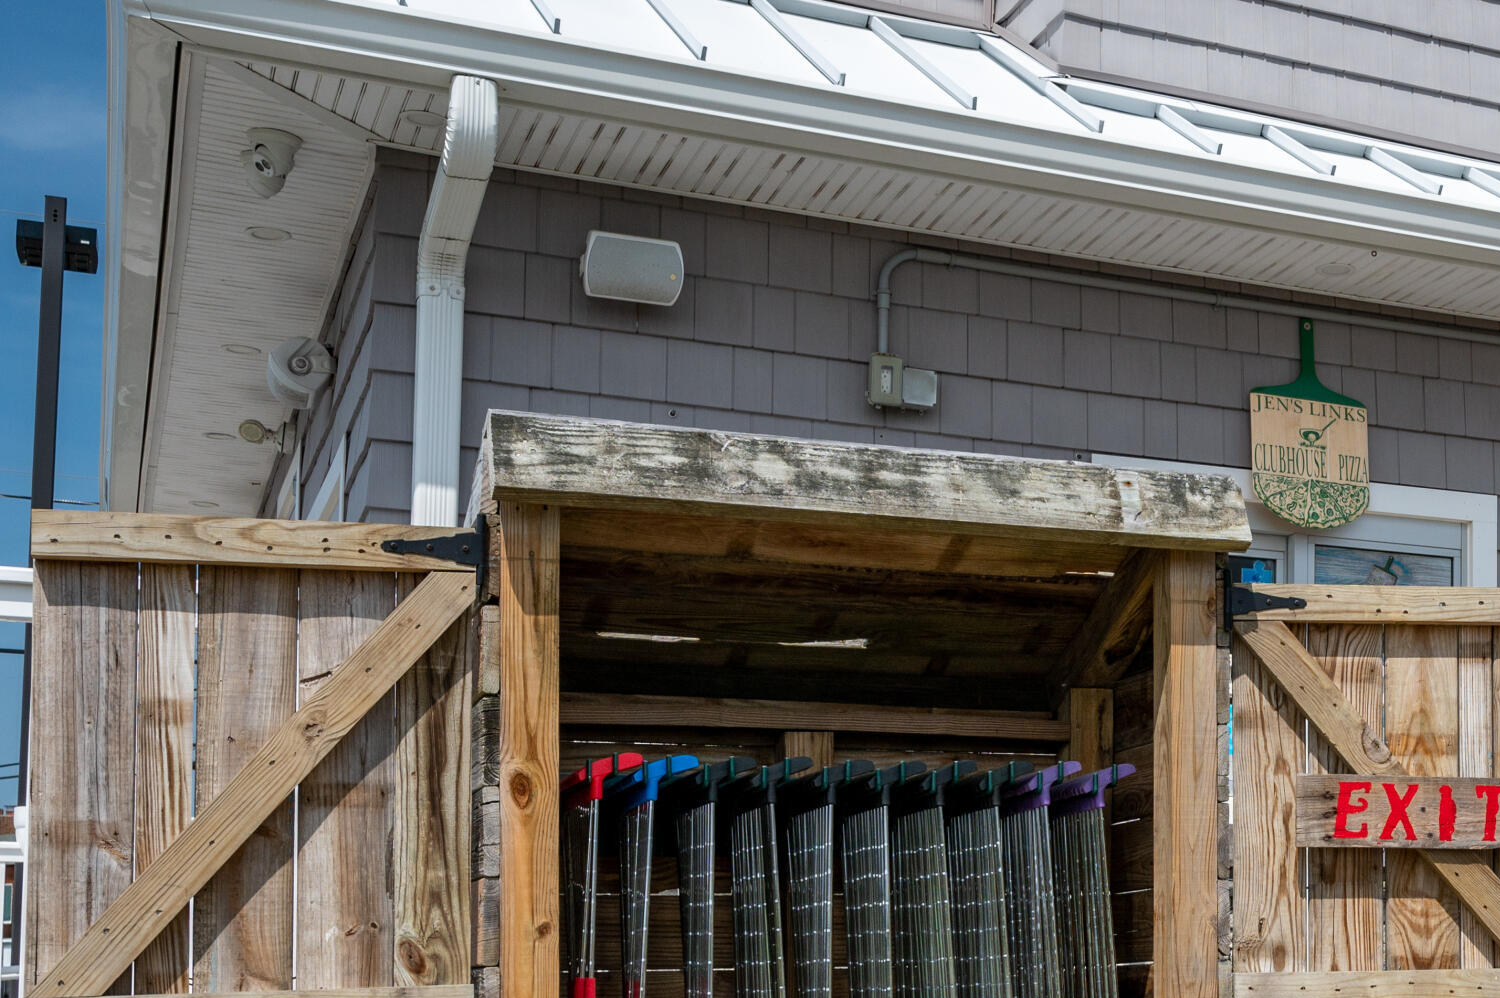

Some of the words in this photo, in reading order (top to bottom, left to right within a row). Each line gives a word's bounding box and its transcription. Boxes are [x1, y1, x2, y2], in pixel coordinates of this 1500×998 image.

[1253, 394, 1303, 414] JEN'S
[1310, 401, 1366, 423] LINKS
[1254, 443, 1327, 479] CLUBHOUSE
[1338, 453, 1369, 484] PIZZA
